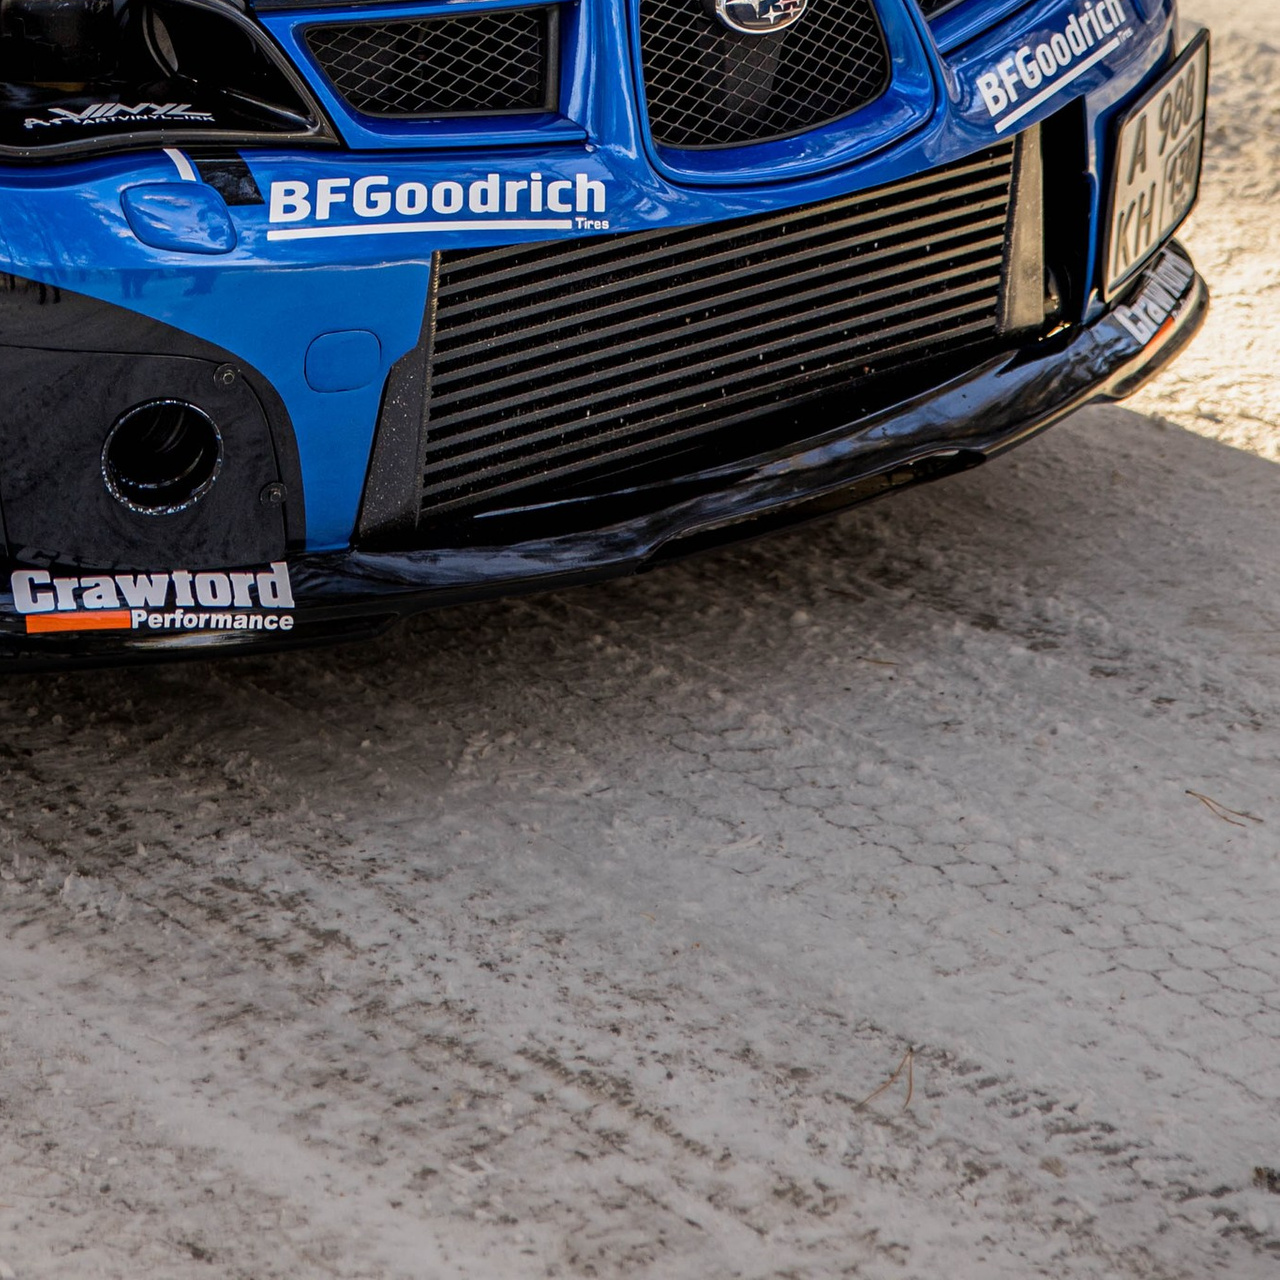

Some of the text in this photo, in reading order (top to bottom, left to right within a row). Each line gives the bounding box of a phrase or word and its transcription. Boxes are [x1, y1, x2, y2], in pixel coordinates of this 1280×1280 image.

[1158, 62, 1196, 157] 988
[269, 172, 606, 223] BFGoodrich
[575, 217, 610, 230] Tires
[131, 609, 294, 630] Performance
